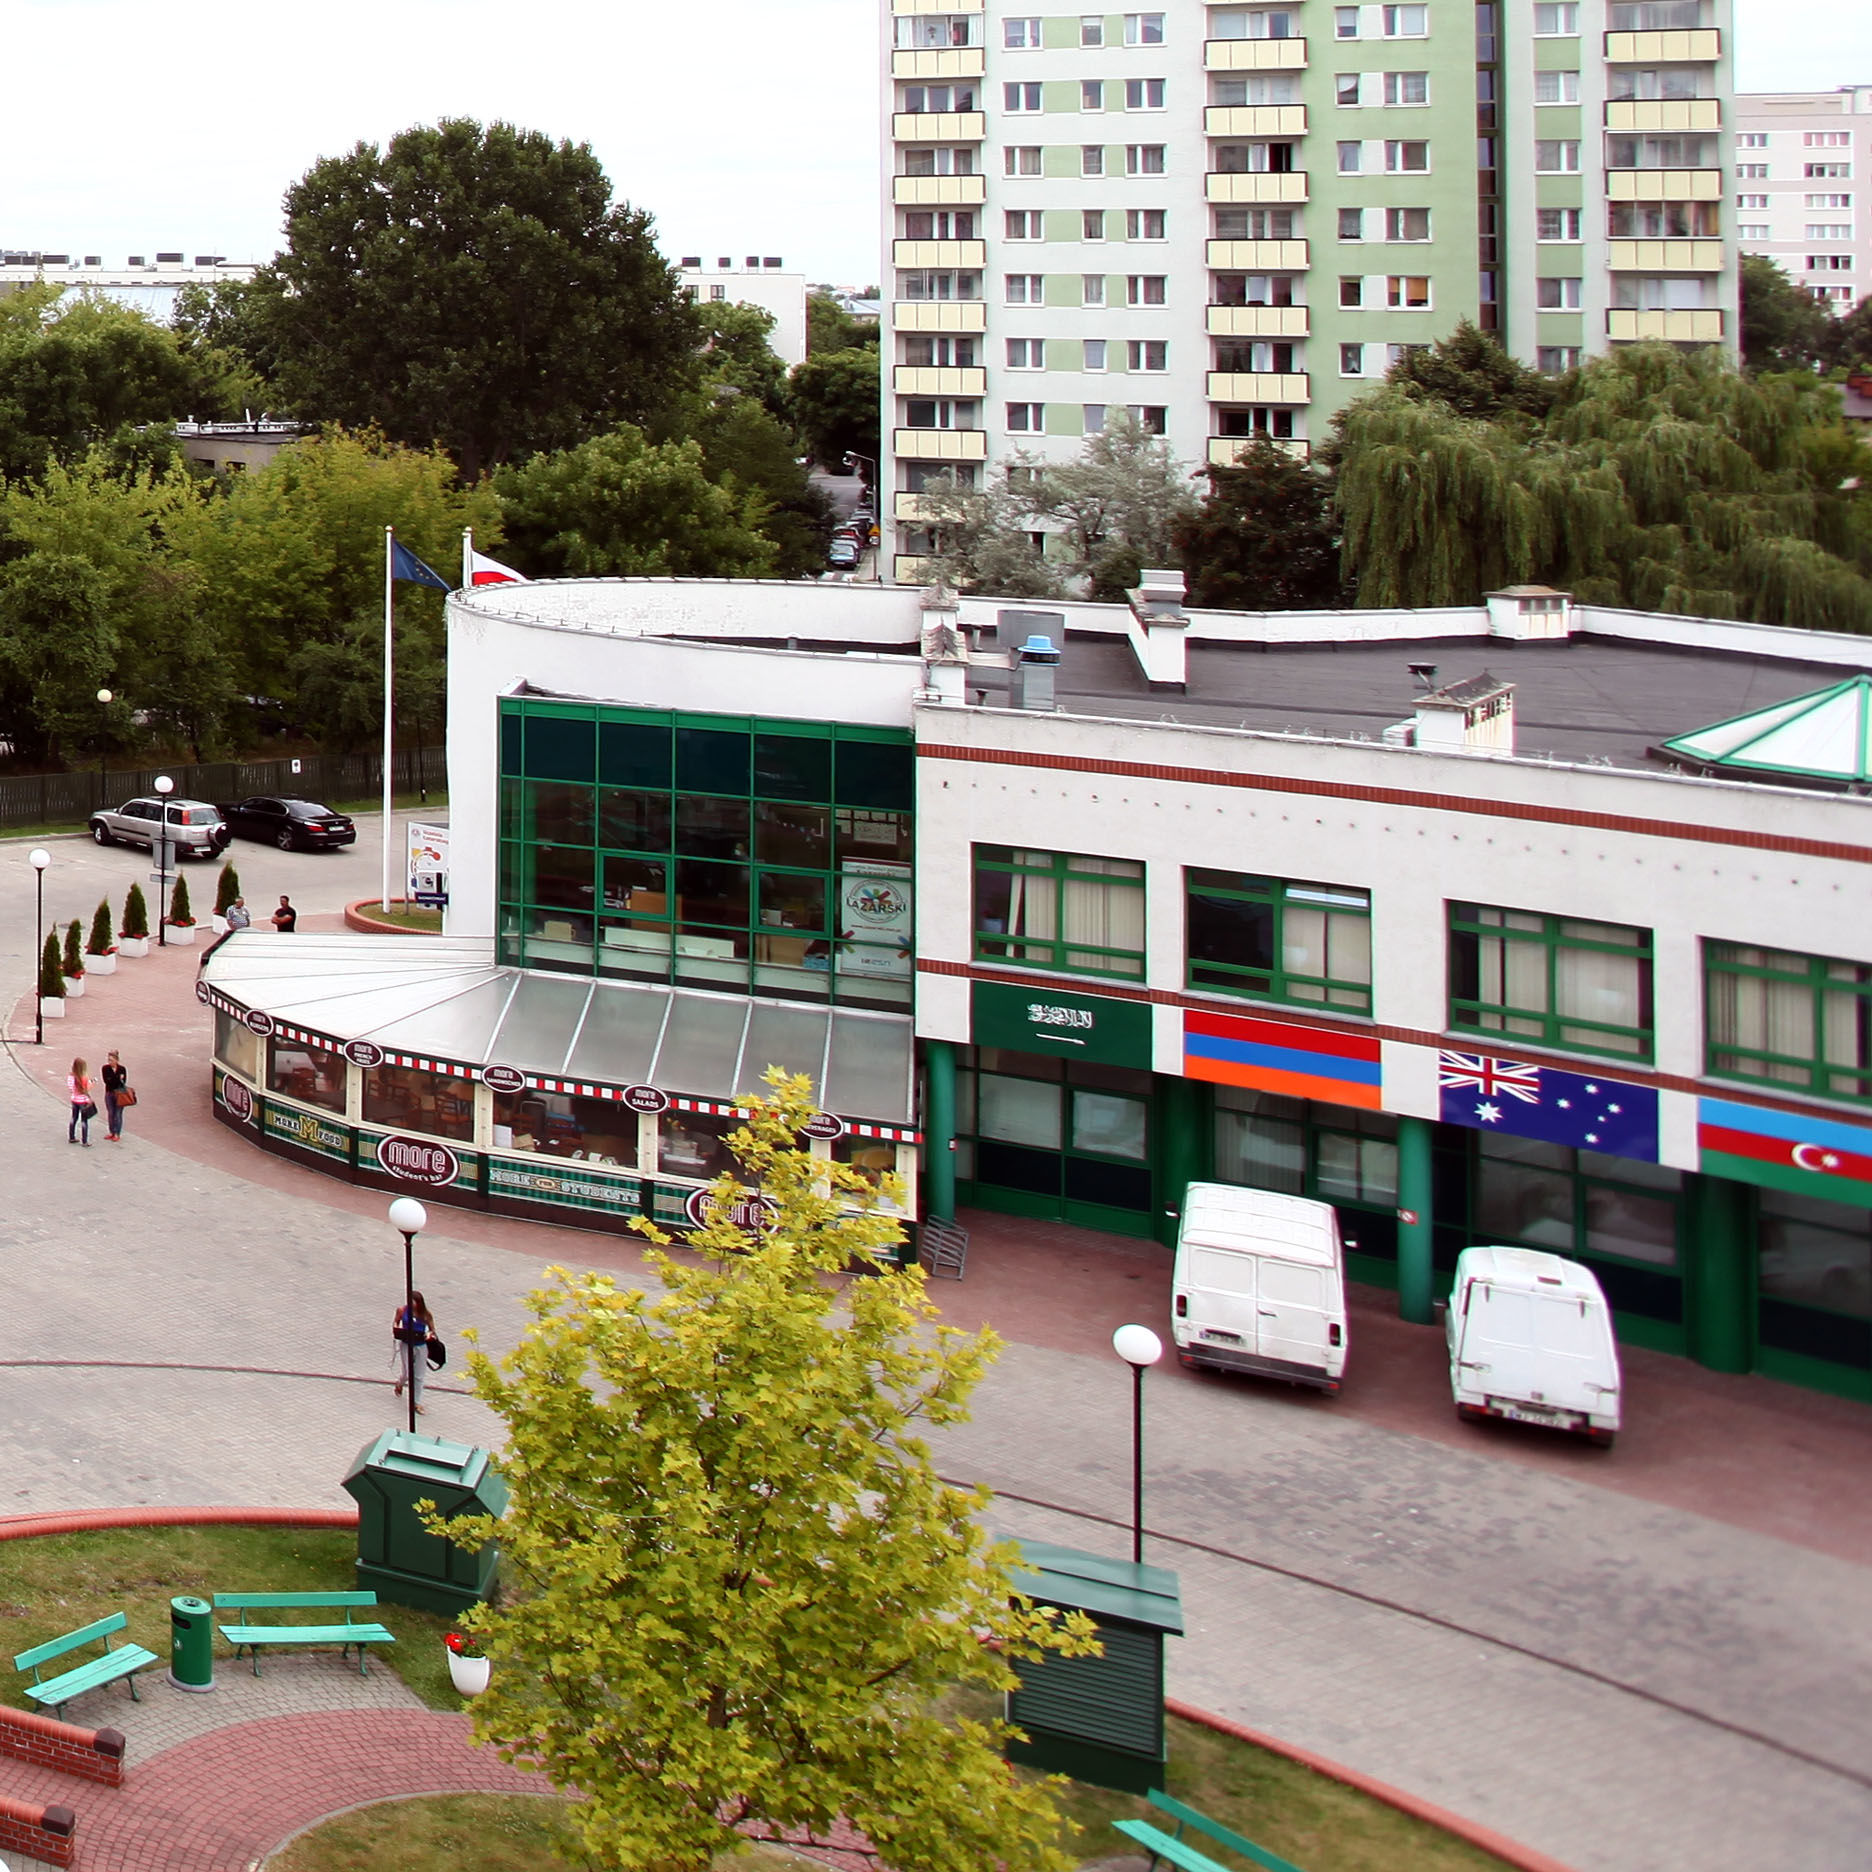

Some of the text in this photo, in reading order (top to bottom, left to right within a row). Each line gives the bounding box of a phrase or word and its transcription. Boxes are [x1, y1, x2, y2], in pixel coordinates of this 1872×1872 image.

[631, 1098, 659, 1108] SALADS
[274, 1114, 342, 1147] MORE M FOOD
[388, 1141, 446, 1173] more
[561, 1181, 641, 1204] STUDENTS
